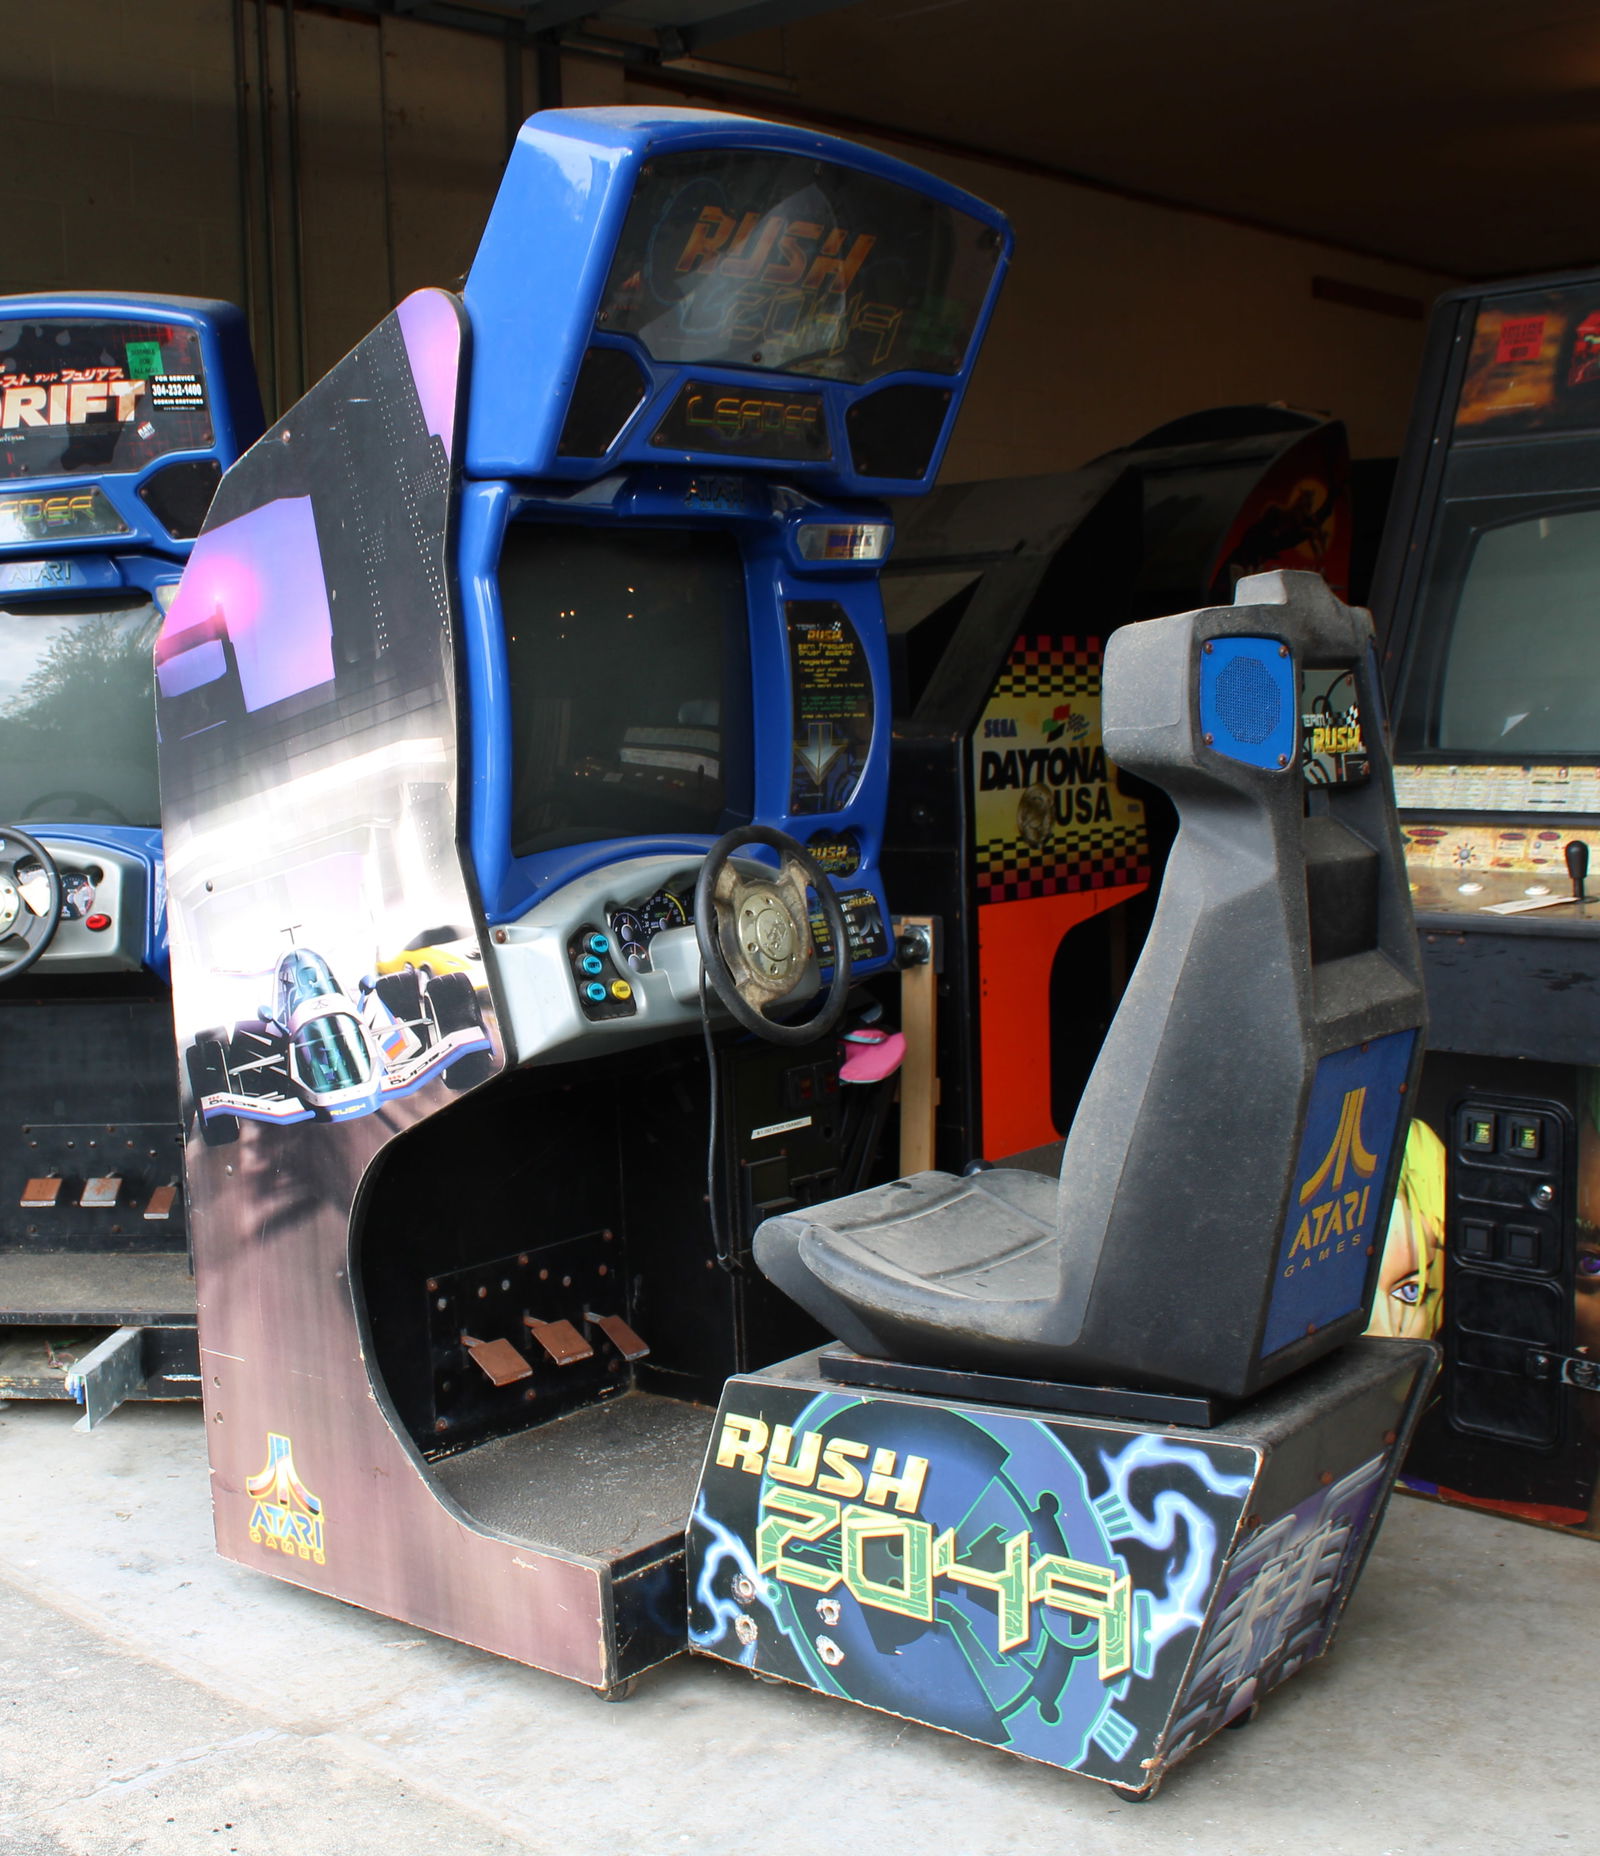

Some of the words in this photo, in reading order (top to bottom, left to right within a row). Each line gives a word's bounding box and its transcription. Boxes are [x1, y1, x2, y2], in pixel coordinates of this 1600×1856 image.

[675, 205, 878, 294] RUSH
[721, 282, 904, 366] 2049
[0, 379, 146, 430] RIFT
[152, 383, 203, 396] 304-232-1400
[9, 561, 71, 584] ATARI
[984, 719, 1018, 738] SEGA
[1313, 726, 1361, 754] RUSH
[980, 745, 1108, 792] DAYTONA
[1055, 786, 1113, 827] USA
[1288, 1185, 1370, 1259] ATARI
[1283, 1234, 1361, 1278] GAMES
[716, 1412, 929, 1514] RUSH
[249, 1500, 324, 1550] ATARI
[249, 1528, 326, 1565] GAMES
[755, 1486, 1132, 1680] 2049
